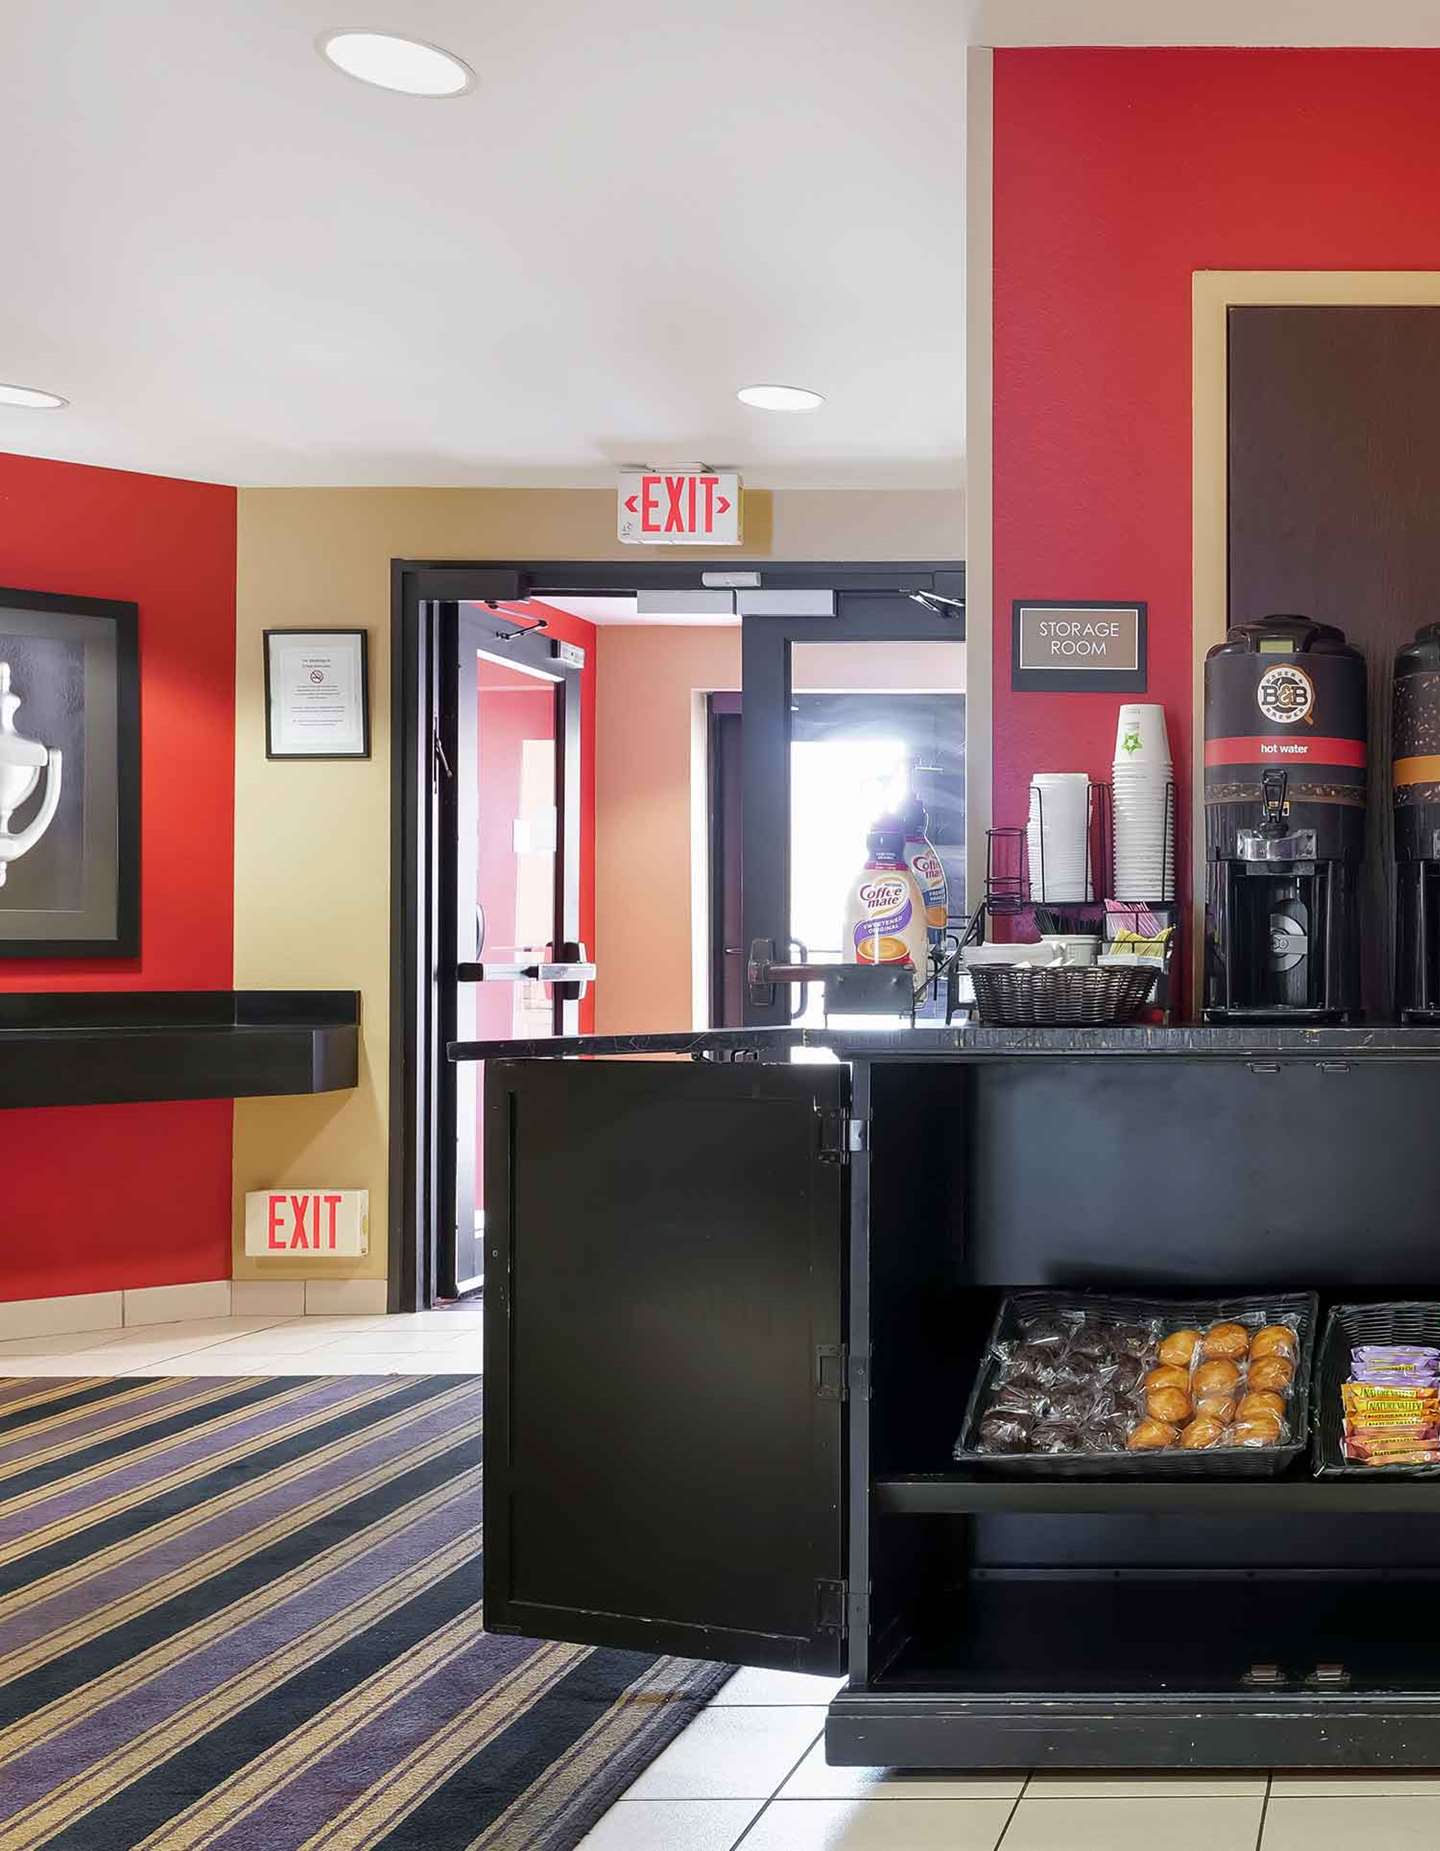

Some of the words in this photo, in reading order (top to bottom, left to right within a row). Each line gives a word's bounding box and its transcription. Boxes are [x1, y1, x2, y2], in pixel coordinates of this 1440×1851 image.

[641, 476, 719, 533] EXIT
[1039, 621, 1120, 637] STORAGE
[1051, 640, 1107, 656] ROOM
[1261, 684, 1309, 708] B&B
[1260, 743, 1278, 753] hot
[1279, 744, 1309, 753] water
[860, 884, 903, 901] Coffee
[867, 895, 900, 909] mate
[268, 1195, 342, 1249] EXIT
